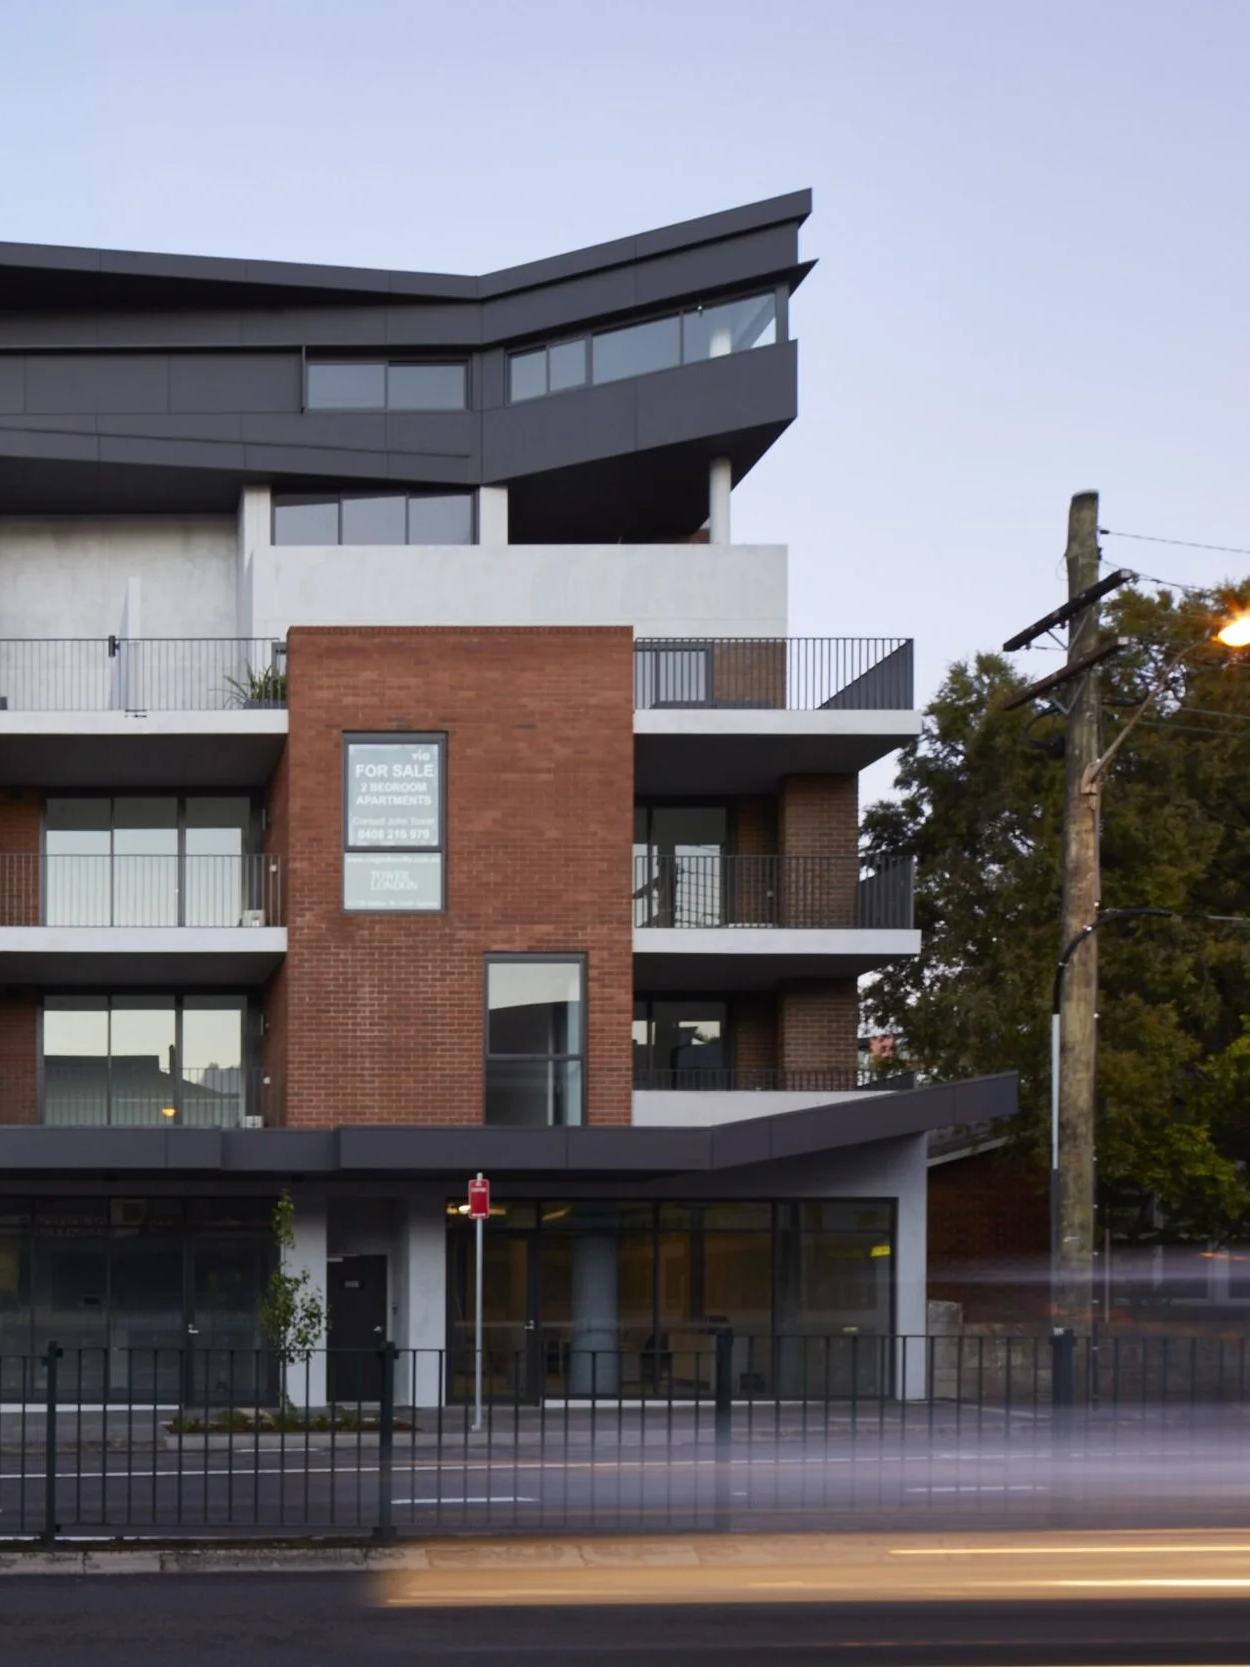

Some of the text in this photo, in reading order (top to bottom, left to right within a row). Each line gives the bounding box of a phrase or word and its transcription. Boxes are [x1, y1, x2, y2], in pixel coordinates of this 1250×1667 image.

[355, 764, 435, 778] FOR SALE
[360, 782, 428, 793] 2 BEDROOM
[356, 795, 432, 806] APARTMENTS
[370, 880, 418, 891] LONDON
